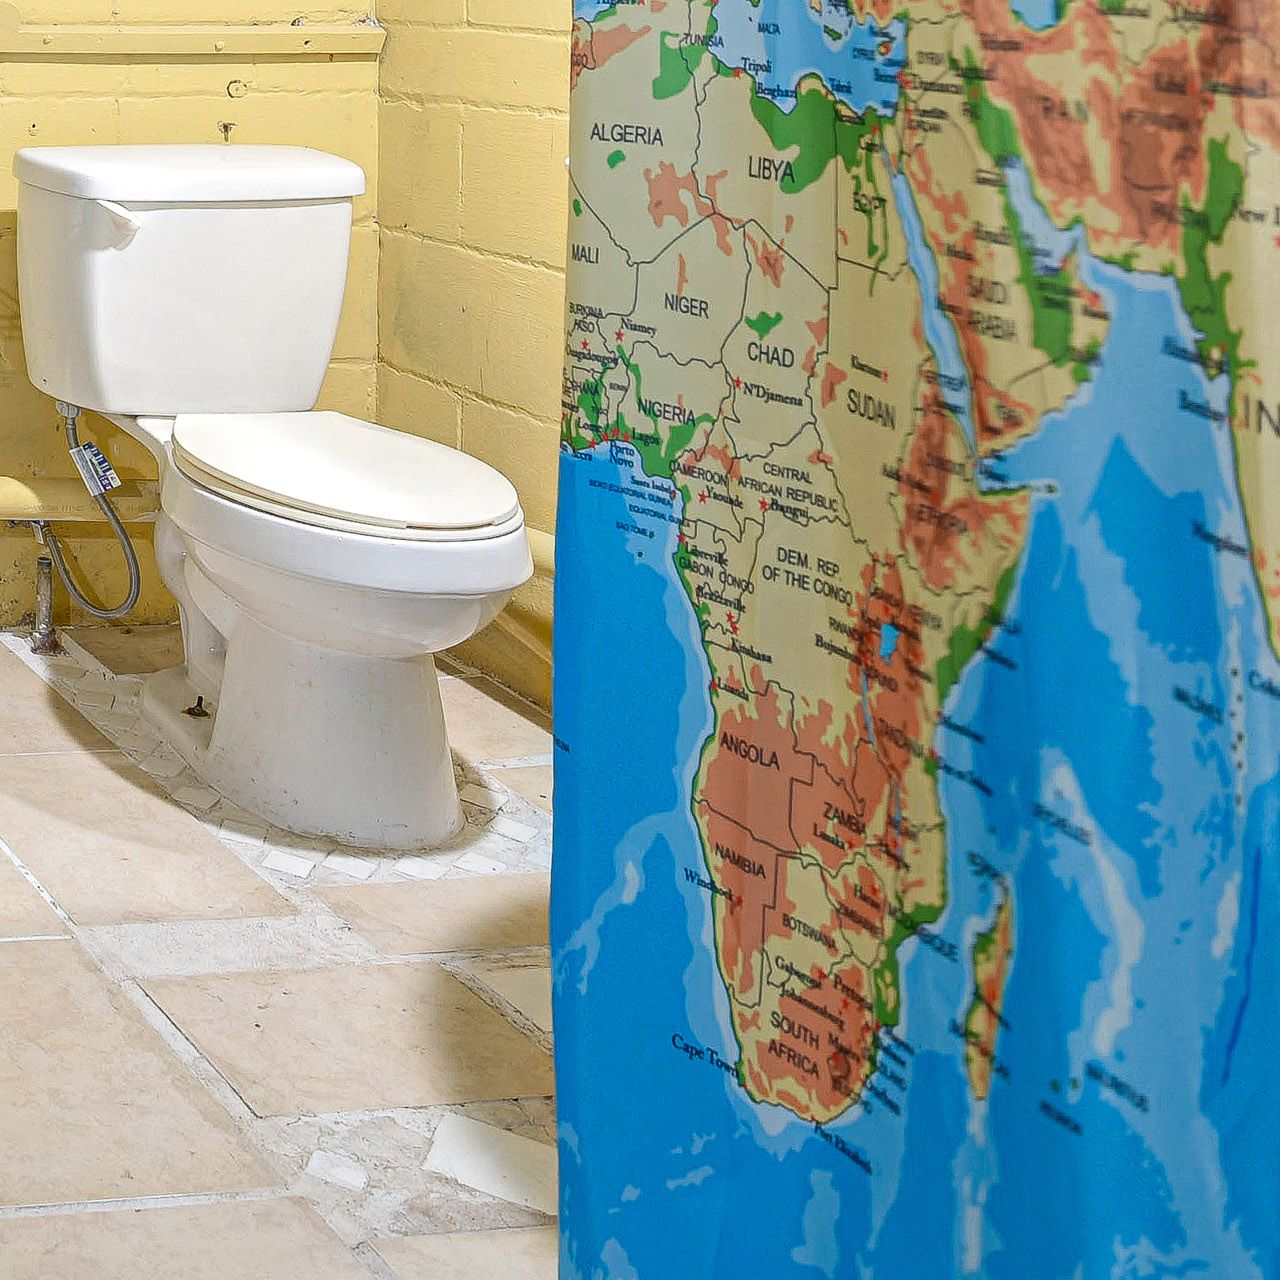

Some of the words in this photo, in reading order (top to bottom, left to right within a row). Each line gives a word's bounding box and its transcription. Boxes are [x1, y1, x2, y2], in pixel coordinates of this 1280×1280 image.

[684, 32, 725, 48] TUNISIA
[590, 122, 664, 147] ALGERIA
[748, 155, 796, 184] LIBYA
[571, 244, 600, 265] MALI
[664, 292, 710, 320] NIGER
[620, 317, 658, 338] Niamey
[747, 342, 795, 369] CHAD
[743, 382, 804, 409] N'Djamena
[638, 398, 696, 427] NIGERIA
[847, 388, 897, 431] SUDAN
[610, 442, 635, 457] Porto
[610, 450, 634, 468] Novo
[670, 460, 729, 487] CAMEROON
[762, 462, 814, 485] CENTRAL
[738, 476, 783, 499] AFRICAN
[786, 486, 839, 513] REPUBLIC
[679, 556, 714, 579] GABON
[778, 546, 812, 570] DEM.
[762, 565, 781, 584] OF
[784, 570, 811, 592] THE
[814, 578, 853, 608] CONGO
[720, 732, 781, 771] ANGOLA
[714, 842, 767, 880] NAMIBIA
[770, 1010, 820, 1051] SOUTH
[671, 1034, 705, 1063] Cape
[768, 1038, 821, 1081] AFRICA
